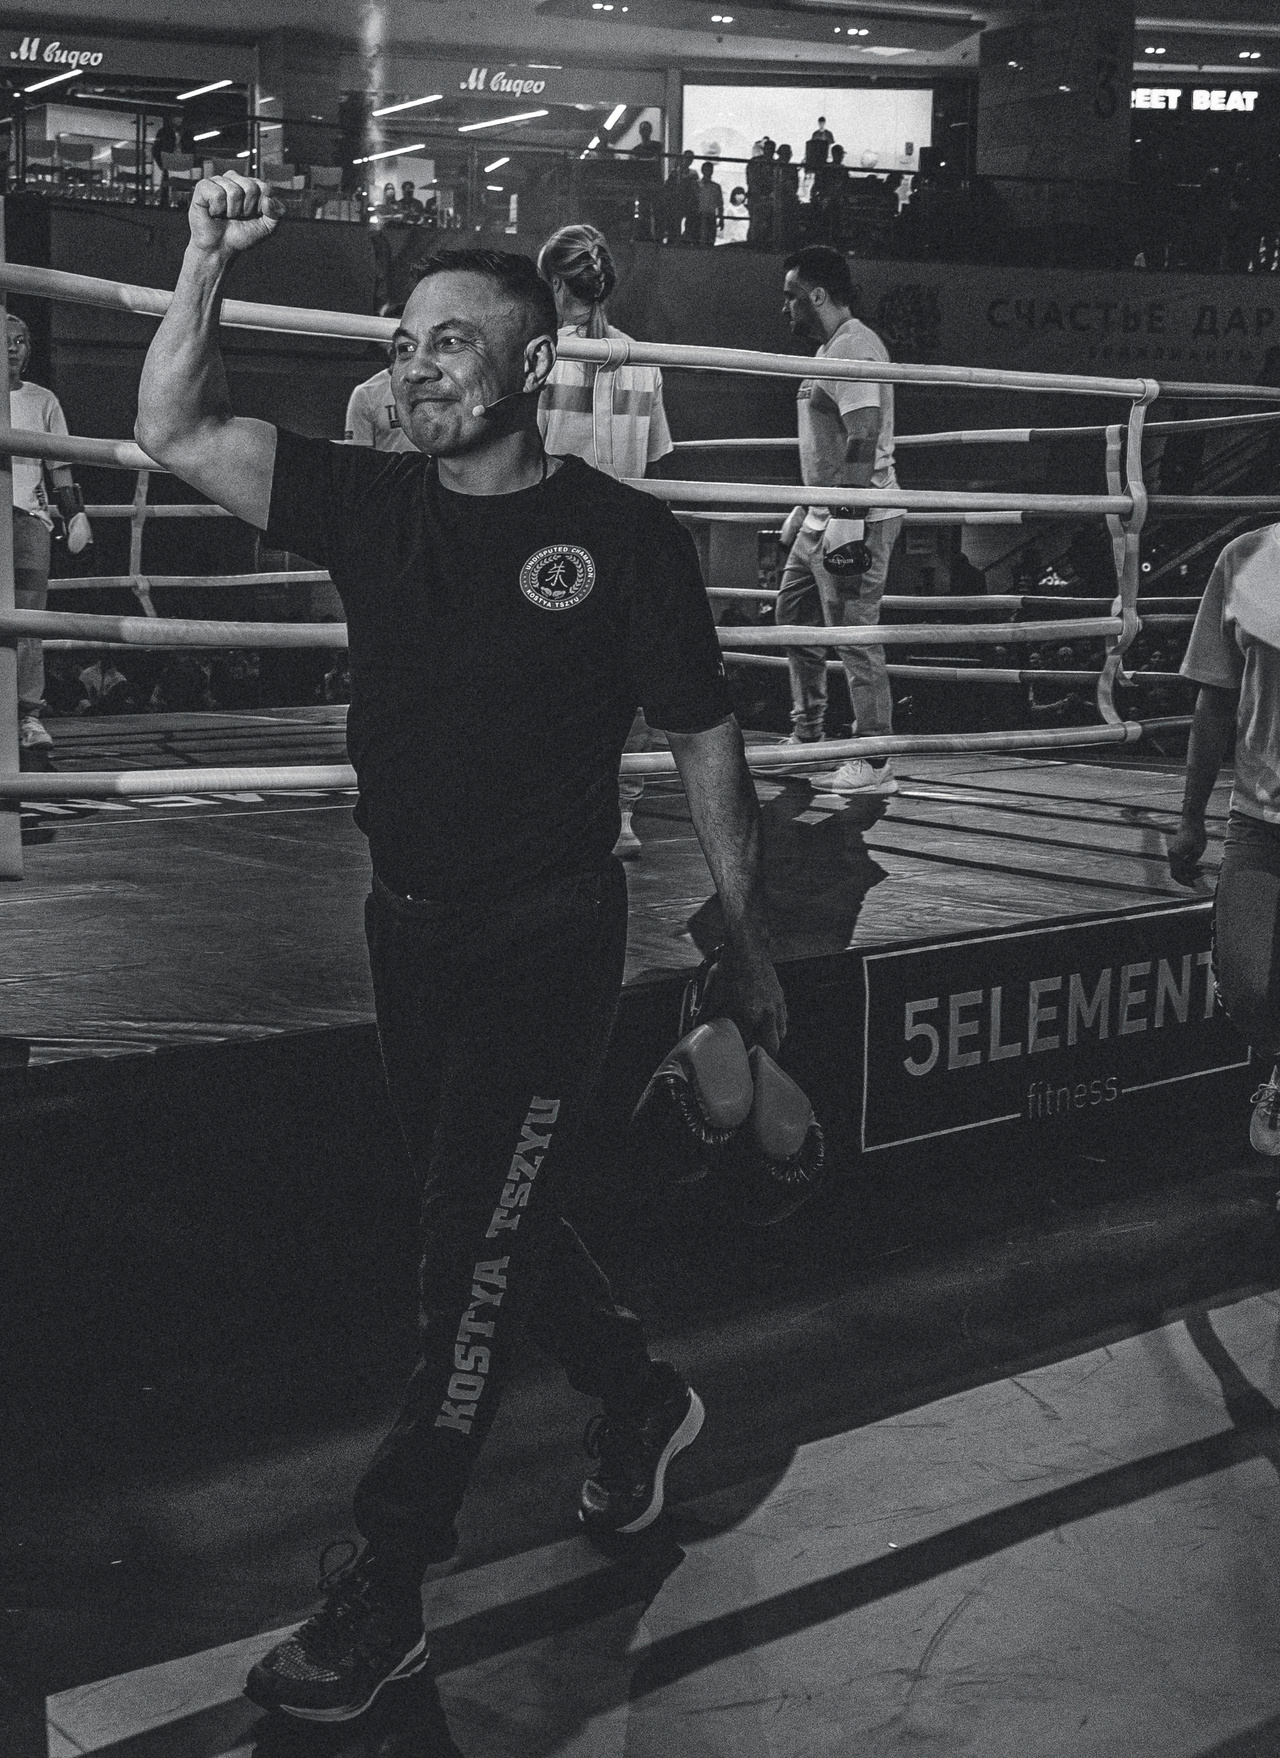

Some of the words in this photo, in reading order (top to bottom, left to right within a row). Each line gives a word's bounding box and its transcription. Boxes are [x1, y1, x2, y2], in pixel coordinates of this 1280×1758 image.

[1191, 89, 1259, 112] BEAT
[985, 298, 1167, 335] СЧАСТЬЕ
[1191, 305, 1277, 341] ДАР
[525, 546, 569, 571] UNDISPUTED
[571, 547, 595, 579] CHAMPION
[525, 589, 552, 608] KOSTYA
[554, 597, 580, 609] TSZYU
[1027, 1076, 1120, 1119] fitness
[434, 1255, 511, 1435] KOSTYA
[485, 1095, 561, 1239] TSZYU
